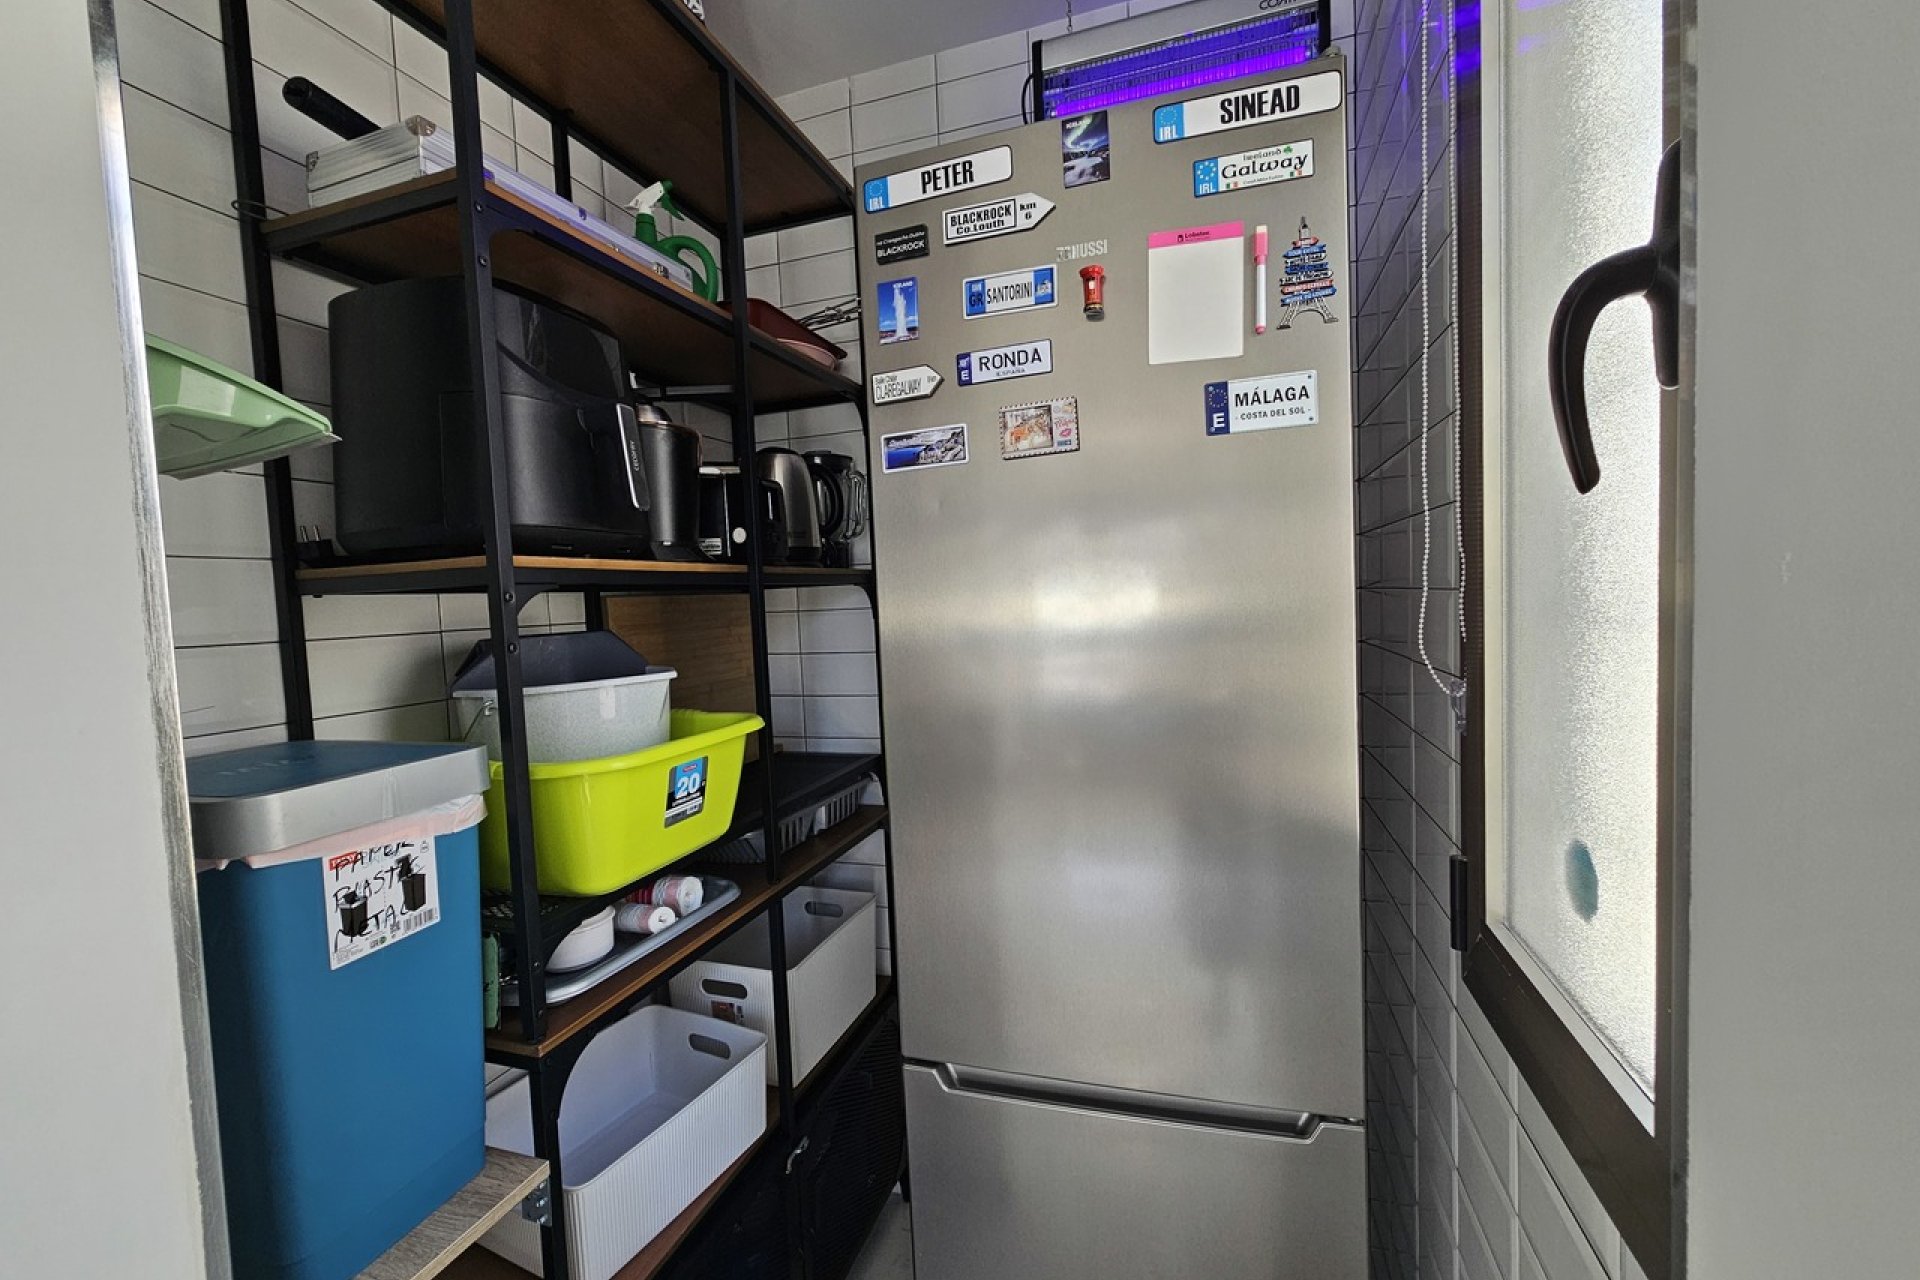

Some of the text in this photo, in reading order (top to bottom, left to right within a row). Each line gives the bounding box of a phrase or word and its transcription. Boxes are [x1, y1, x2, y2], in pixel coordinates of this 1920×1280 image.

[1220, 84, 1300, 124] SINEAD
[1159, 126, 1178, 142] IRL
[921, 159, 974, 194] PETER
[1221, 154, 1308, 179] Galway
[1200, 182, 1217, 194] IRL
[950, 204, 1012, 227] BLACKROCK
[969, 291, 985, 308] GR
[986, 281, 1033, 305] SANTORINI
[979, 347, 1042, 372] RONDA
[1235, 385, 1310, 408] MÁLAGA
[1213, 412, 1225, 428] E
[1240, 406, 1305, 421] COSTA DEL SOL
[675, 772, 701, 801] 20
